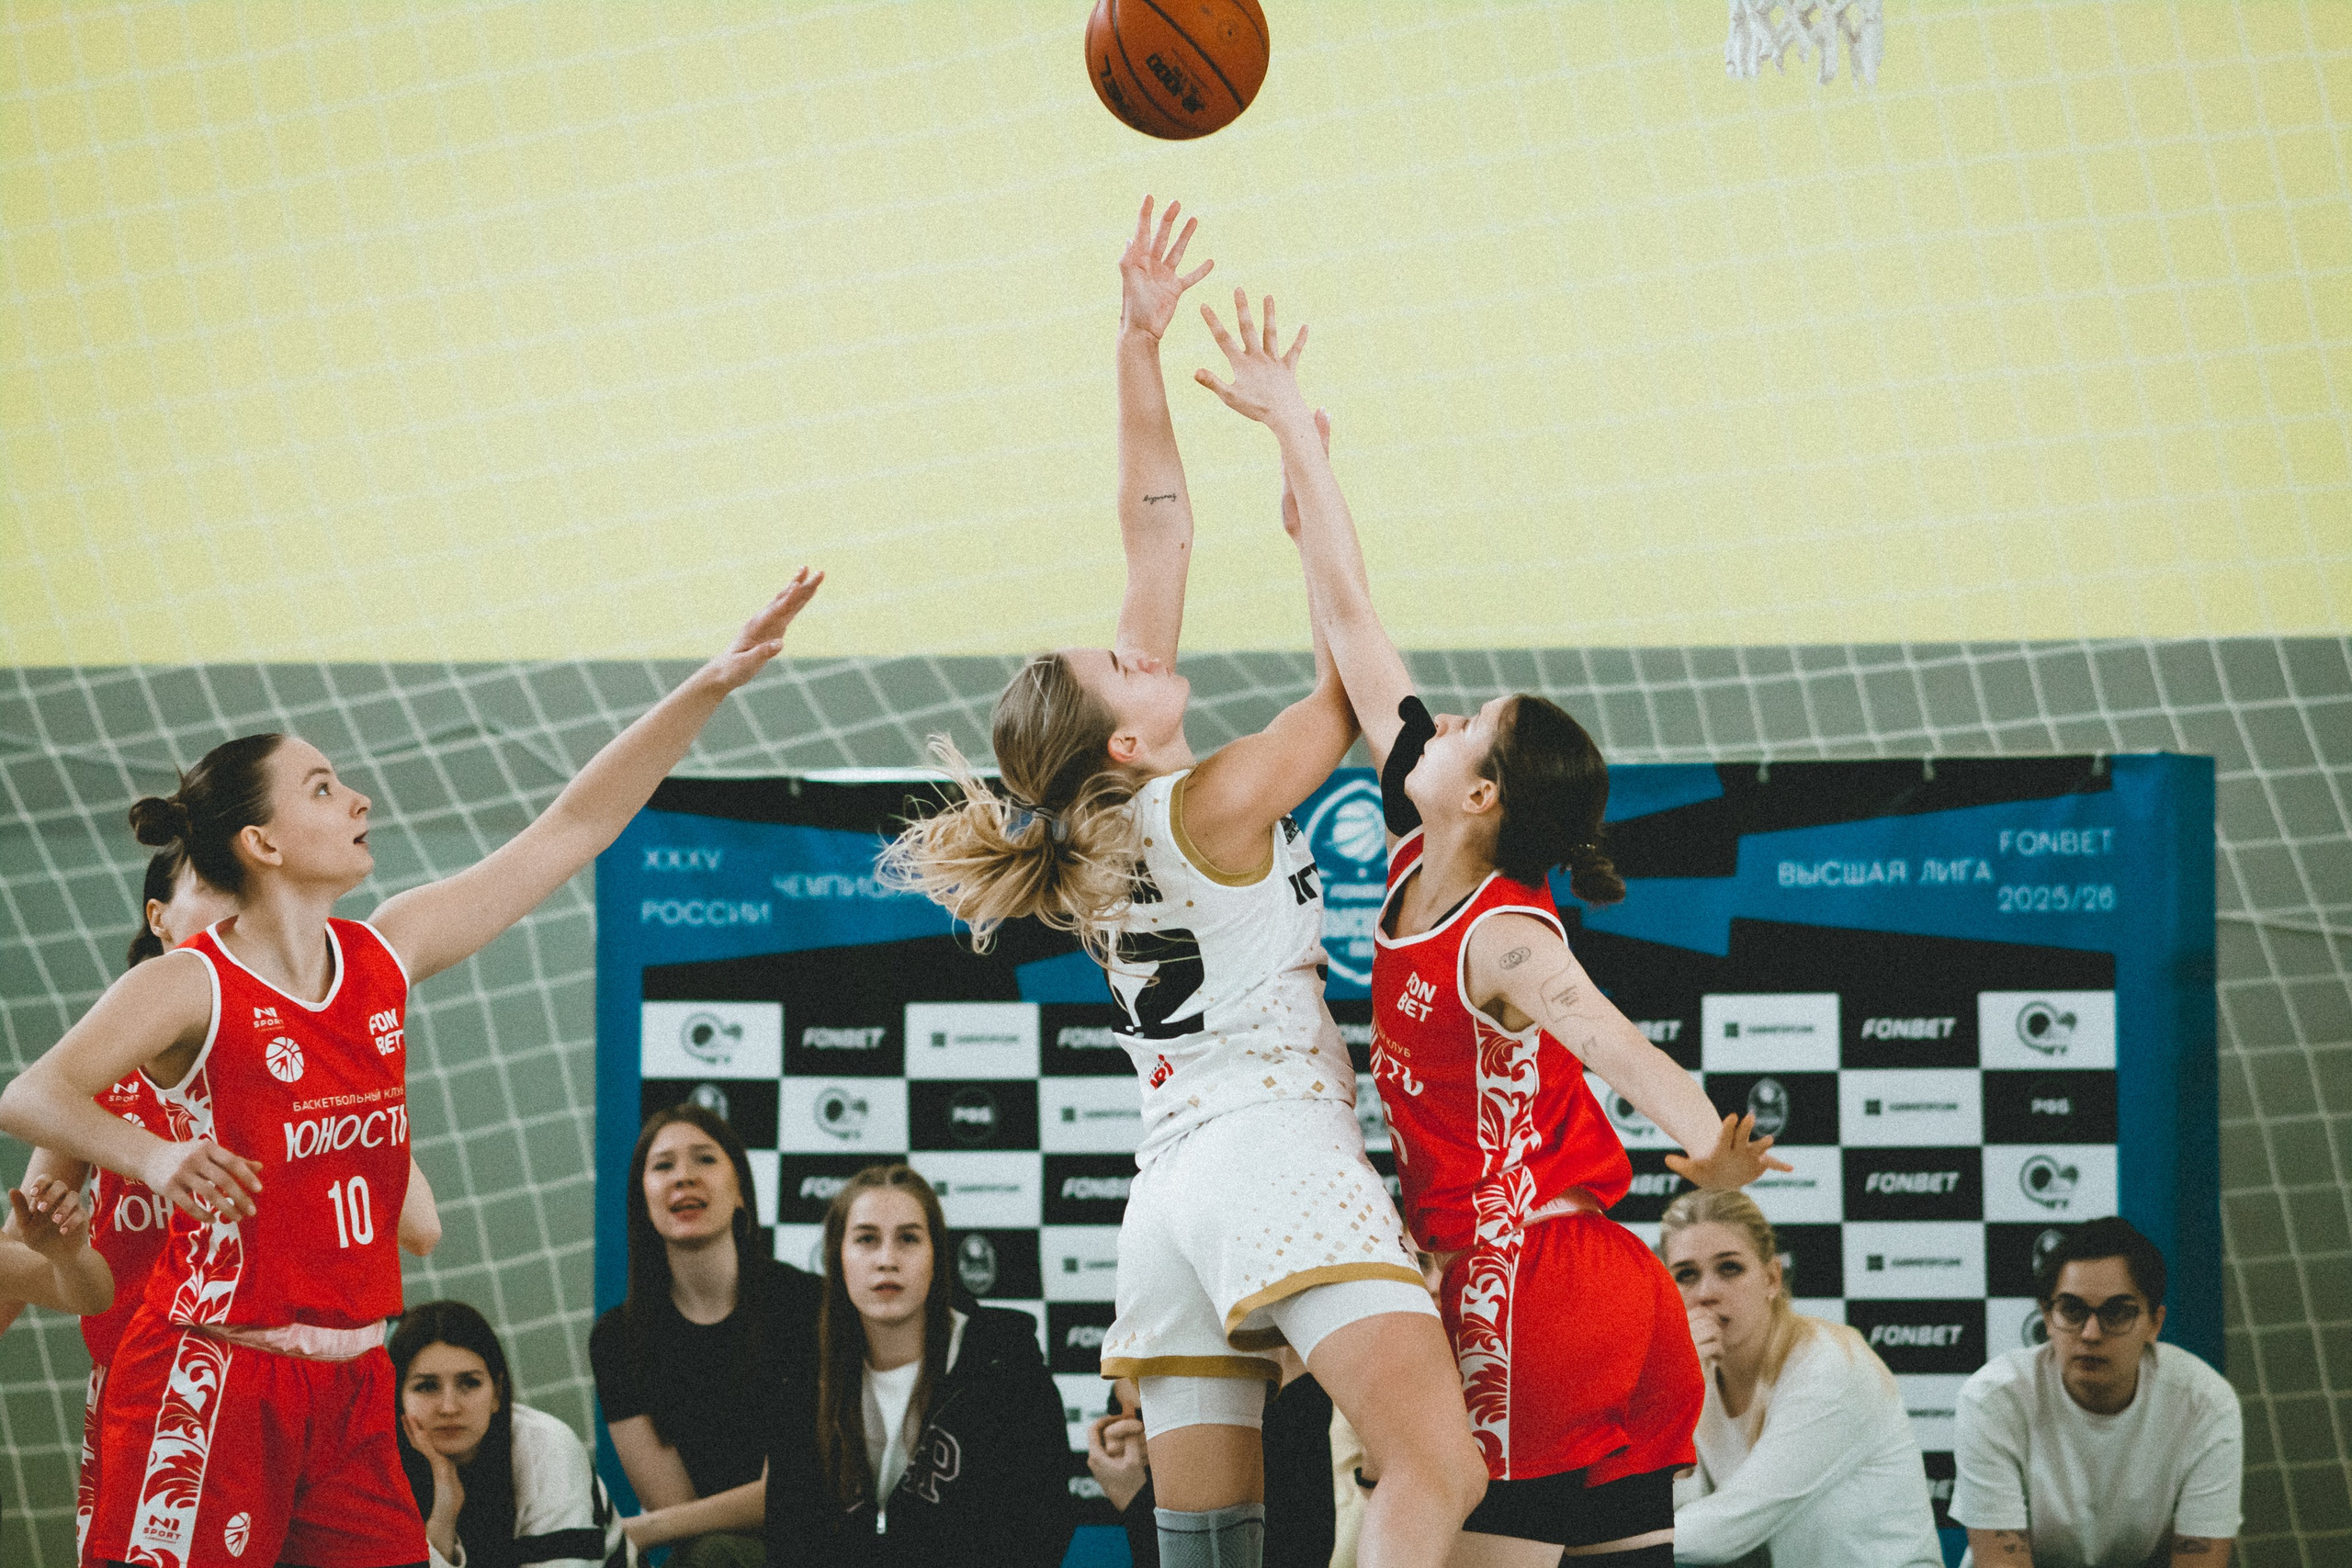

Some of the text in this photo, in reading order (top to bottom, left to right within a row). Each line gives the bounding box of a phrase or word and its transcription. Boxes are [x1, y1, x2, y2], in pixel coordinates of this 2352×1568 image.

[1998, 829, 2112, 856] FONBET
[644, 849, 721, 870] XXXV
[1777, 858, 1995, 886] ВЫСШАЯ ЛИГА
[1997, 885, 2114, 912] 2025/26
[641, 900, 772, 927] РОССИИ
[1406, 971, 1437, 1003] FON
[1396, 991, 1433, 1022] BET
[369, 1009, 399, 1035] FON
[1861, 1017, 1957, 1040] FONBET
[375, 1030, 403, 1055] BET
[802, 1026, 887, 1050] FONBET
[108, 1094, 141, 1102] SPORT
[293, 1089, 381, 1111] БАСКЕТБОЛЬНЫЙ
[283, 1104, 408, 1162] ЮНОСТЬ
[1865, 1171, 1960, 1194] FONBET
[327, 1175, 374, 1248] 10
[1870, 1324, 1963, 1346] FONBET
[142, 1527, 182, 1540] SPORT
